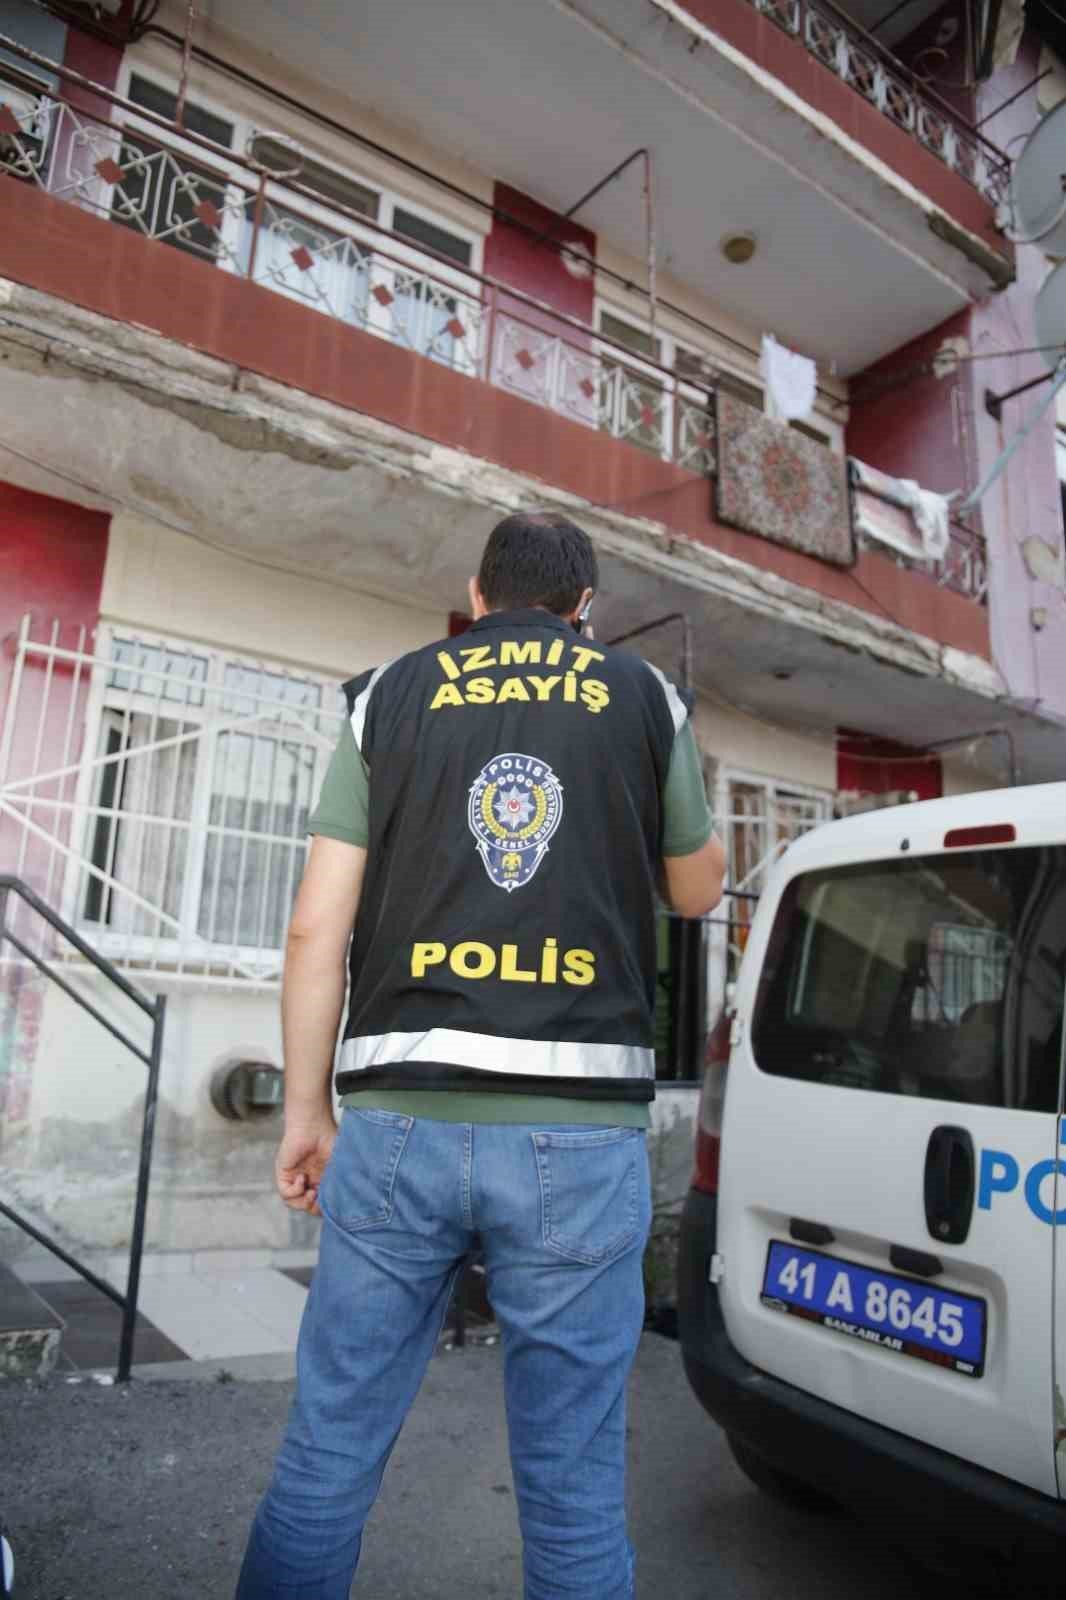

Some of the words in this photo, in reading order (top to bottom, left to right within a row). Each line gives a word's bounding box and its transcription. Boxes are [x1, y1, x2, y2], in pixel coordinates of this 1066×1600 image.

[437, 639, 605, 680] İZMİT
[430, 670, 610, 713] ASAYİŞ
[411, 938, 595, 985] POLİS
[778, 1257, 816, 1300] 41
[826, 1273, 854, 1313] A
[865, 1282, 964, 1346] 8645
